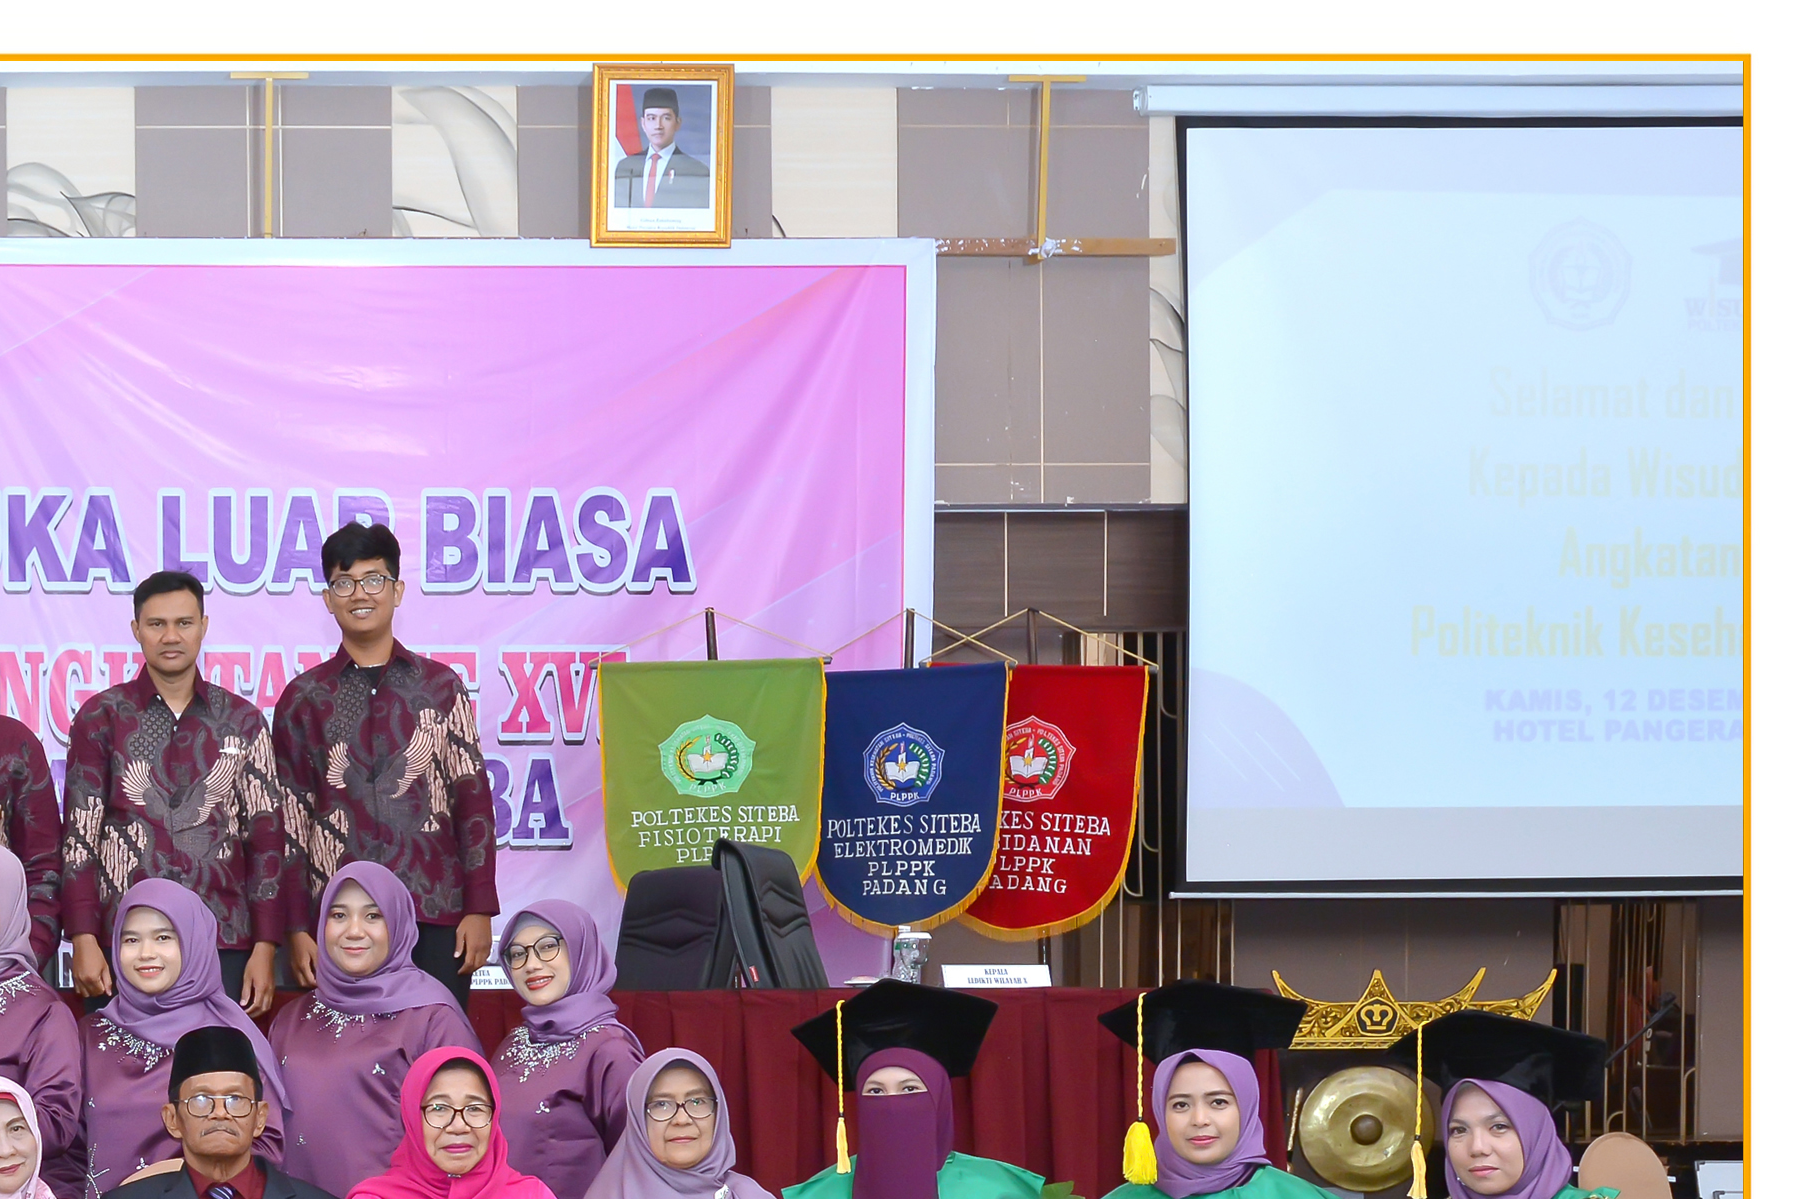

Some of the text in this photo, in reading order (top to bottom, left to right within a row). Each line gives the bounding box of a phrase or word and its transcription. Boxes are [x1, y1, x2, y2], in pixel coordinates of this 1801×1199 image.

[1489, 365, 1735, 420] Selamat dan
[1468, 444, 1743, 509] Kepada Wisud
[421, 486, 697, 594] BIASA
[1557, 525, 1742, 590] Angkatan
[1410, 604, 1743, 658] Politeknik Keseh
[1484, 687, 1743, 717] KAMIS, 12 DESEM
[1493, 718, 1743, 743] HOTEL PANGERA
[890, 792, 920, 802] PLPPK
[1008, 787, 1043, 798] PLPPK
[630, 804, 800, 828] POLTEKES SITEBA
[826, 814, 914, 839] POLTEKES
[919, 813, 982, 835] SITEBA
[1040, 812, 1111, 837] SITEBA
[638, 826, 782, 848] FISIOTERAPI
[834, 837, 974, 859] ELEKTROMEDIK
[996, 834, 1092, 856] IDANAN
[676, 847, 714, 863] PLP
[993, 855, 1056, 875] LPPK
[867, 860, 936, 877] PLPPK
[862, 879, 947, 896] PADANG
[989, 874, 1067, 895] ADANG
[984, 968, 1009, 976] KEPALA
[994, 977, 1022, 985] WILAYAH
